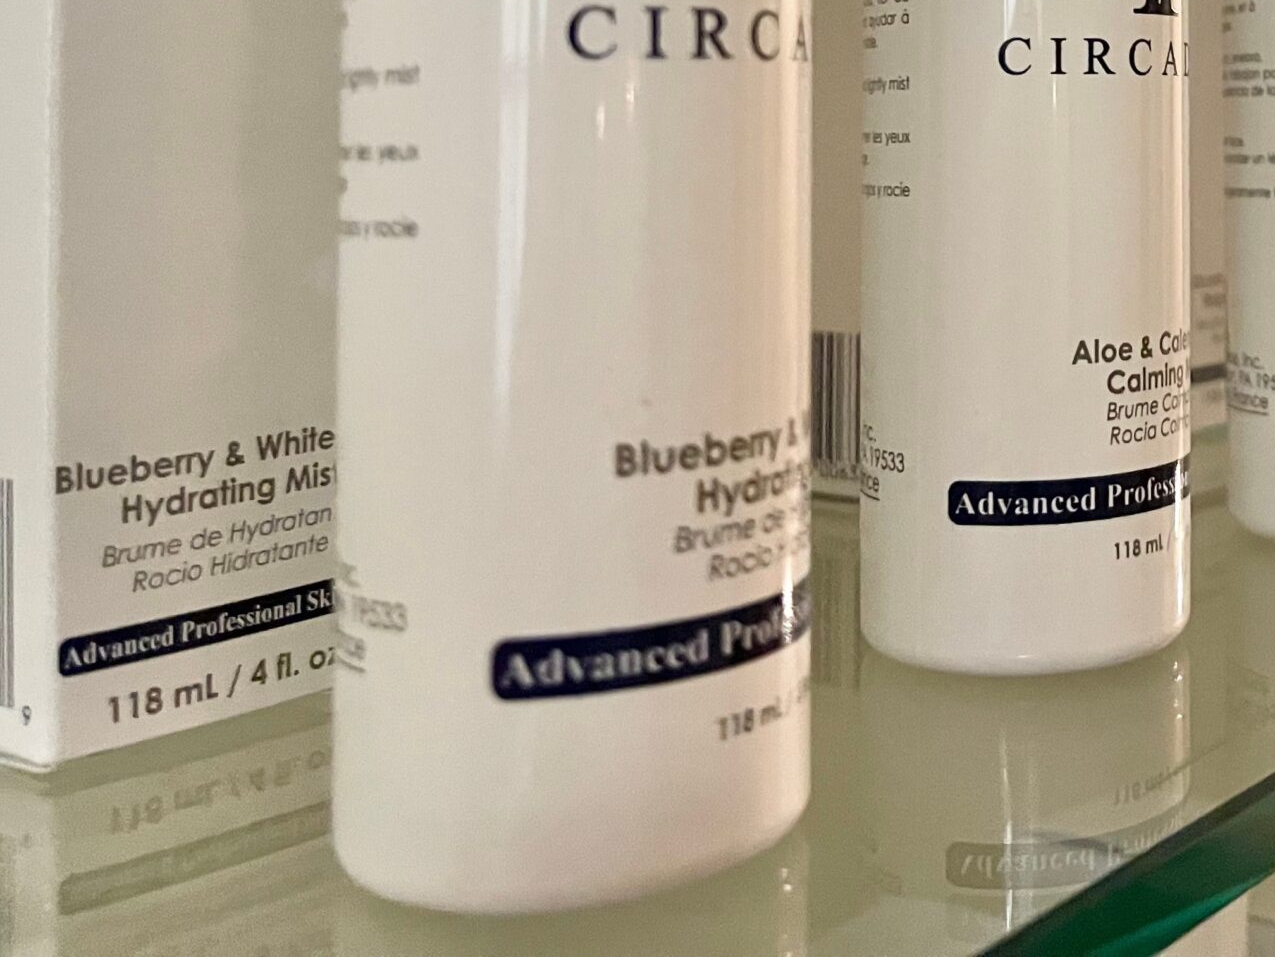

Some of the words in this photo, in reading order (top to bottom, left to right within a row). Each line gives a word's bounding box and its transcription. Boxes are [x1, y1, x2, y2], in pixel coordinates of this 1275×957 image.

[889, 76, 910, 90] mist
[885, 132, 911, 146] yeux
[883, 182, 911, 197] rocie
[1072, 339, 1133, 365] Aloe
[1141, 335, 1153, 359] &
[1107, 362, 1184, 394] Calming
[1106, 400, 1159, 421] Brume
[56, 450, 215, 494] Blueberry
[225, 441, 245, 466] &
[256, 427, 335, 461] White
[615, 430, 782, 477] Blueberry
[869, 445, 905, 473] 19533
[122, 476, 275, 527] Hydrating
[955, 487, 1096, 515] Advanced
[1108, 476, 1188, 508] Profess
[102, 538, 182, 568] Brume
[190, 528, 222, 550] de
[230, 507, 332, 545] Hydratan
[673, 518, 757, 553] Brume
[1114, 539, 1141, 560] 118
[132, 560, 202, 593] Rocio
[210, 534, 329, 576] Hidratante
[64, 625, 174, 670] Advanced
[182, 594, 302, 643] Professional
[502, 629, 709, 690] Advanced
[109, 687, 163, 724] 118
[174, 673, 219, 708] mL
[226, 664, 242, 698] /
[251, 658, 267, 685] 4
[277, 651, 300, 681] fl.
[717, 708, 754, 741] 118
